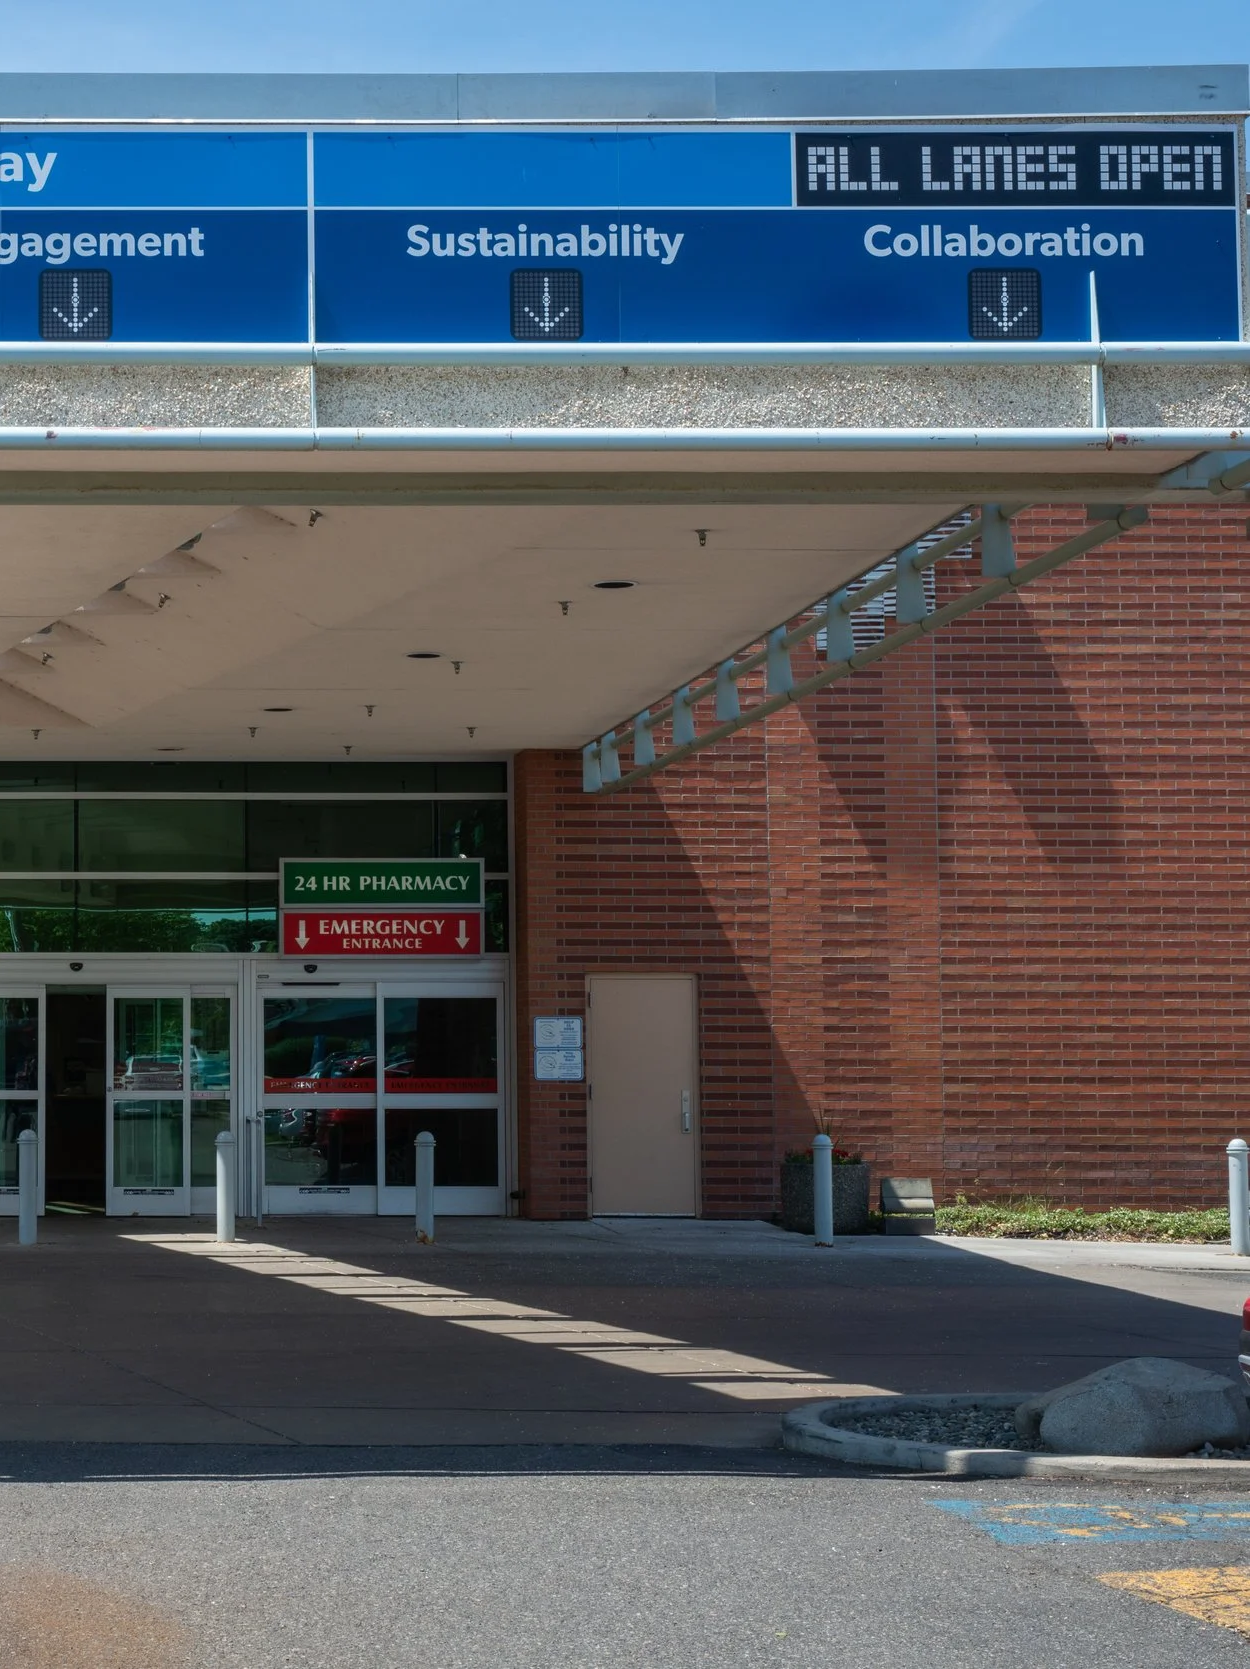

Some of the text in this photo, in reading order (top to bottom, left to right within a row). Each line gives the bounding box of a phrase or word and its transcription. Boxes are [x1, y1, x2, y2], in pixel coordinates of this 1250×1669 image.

[807, 145, 1223, 191] ALL LANES OPEN
[405, 223, 685, 265] Sustainability
[862, 222, 1145, 257] Collaboration
[294, 875, 471, 891] 24 HR PHARMACY
[318, 919, 446, 935] EMERGENCY
[342, 937, 423, 949] ENTRANCE
